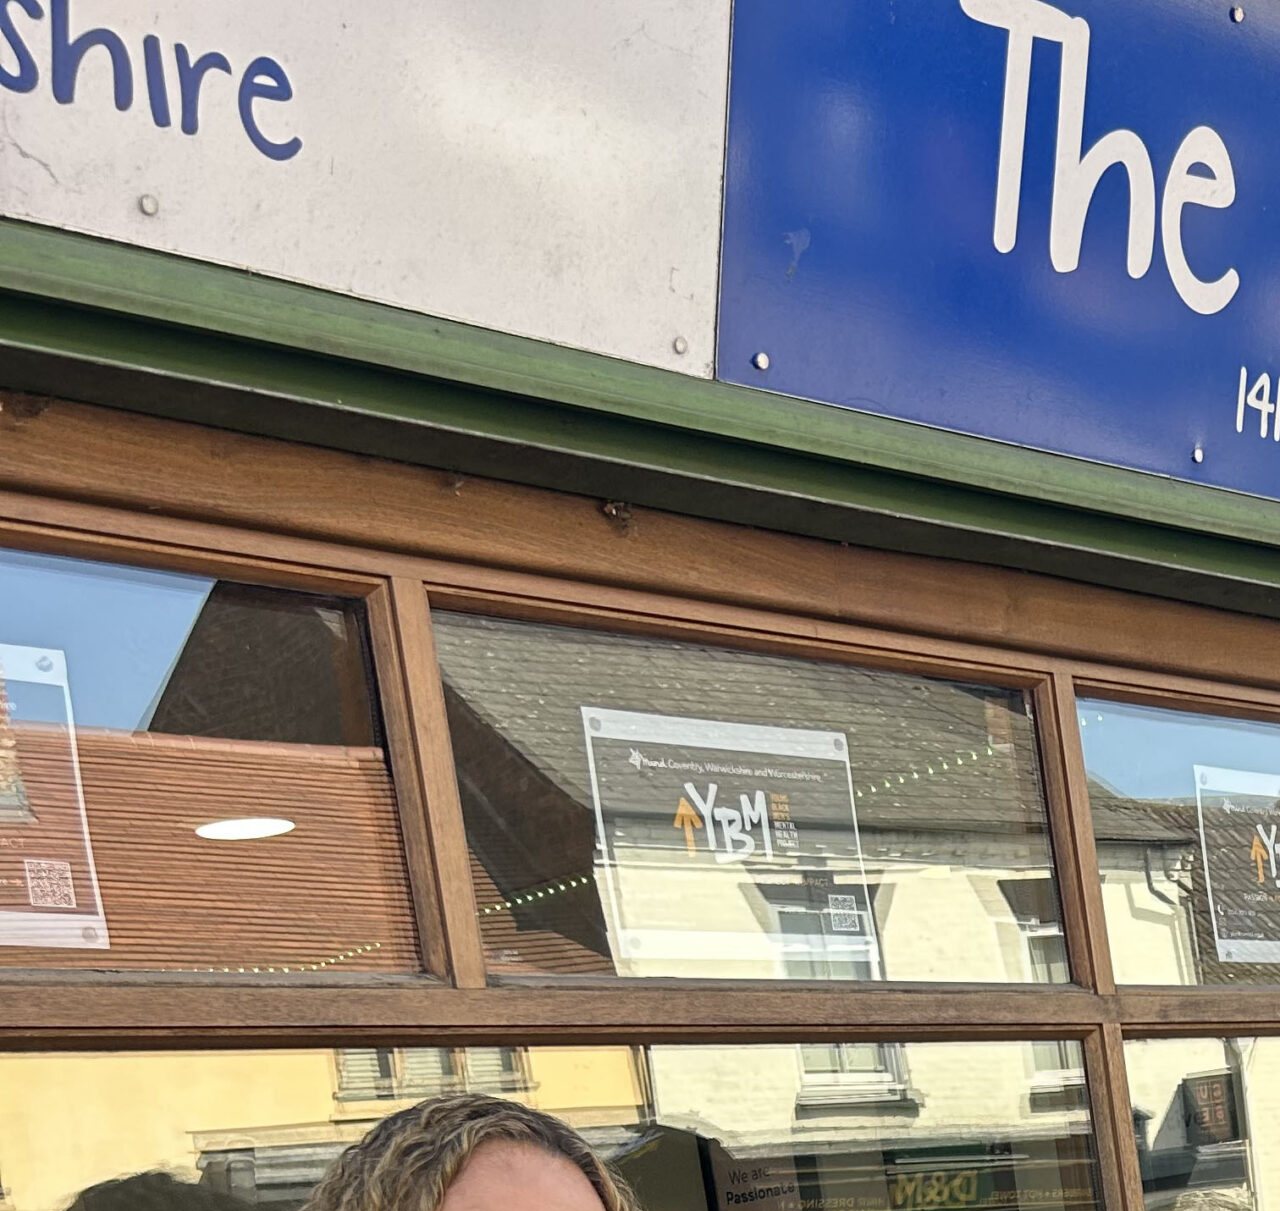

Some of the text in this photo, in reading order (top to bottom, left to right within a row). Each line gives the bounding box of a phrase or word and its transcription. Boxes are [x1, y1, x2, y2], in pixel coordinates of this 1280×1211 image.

[959, 0, 1240, 315] The
[684, 782, 774, 864] YBM
[726, 1181, 795, 1206] Passionate
[728, 1169, 750, 1185] We
